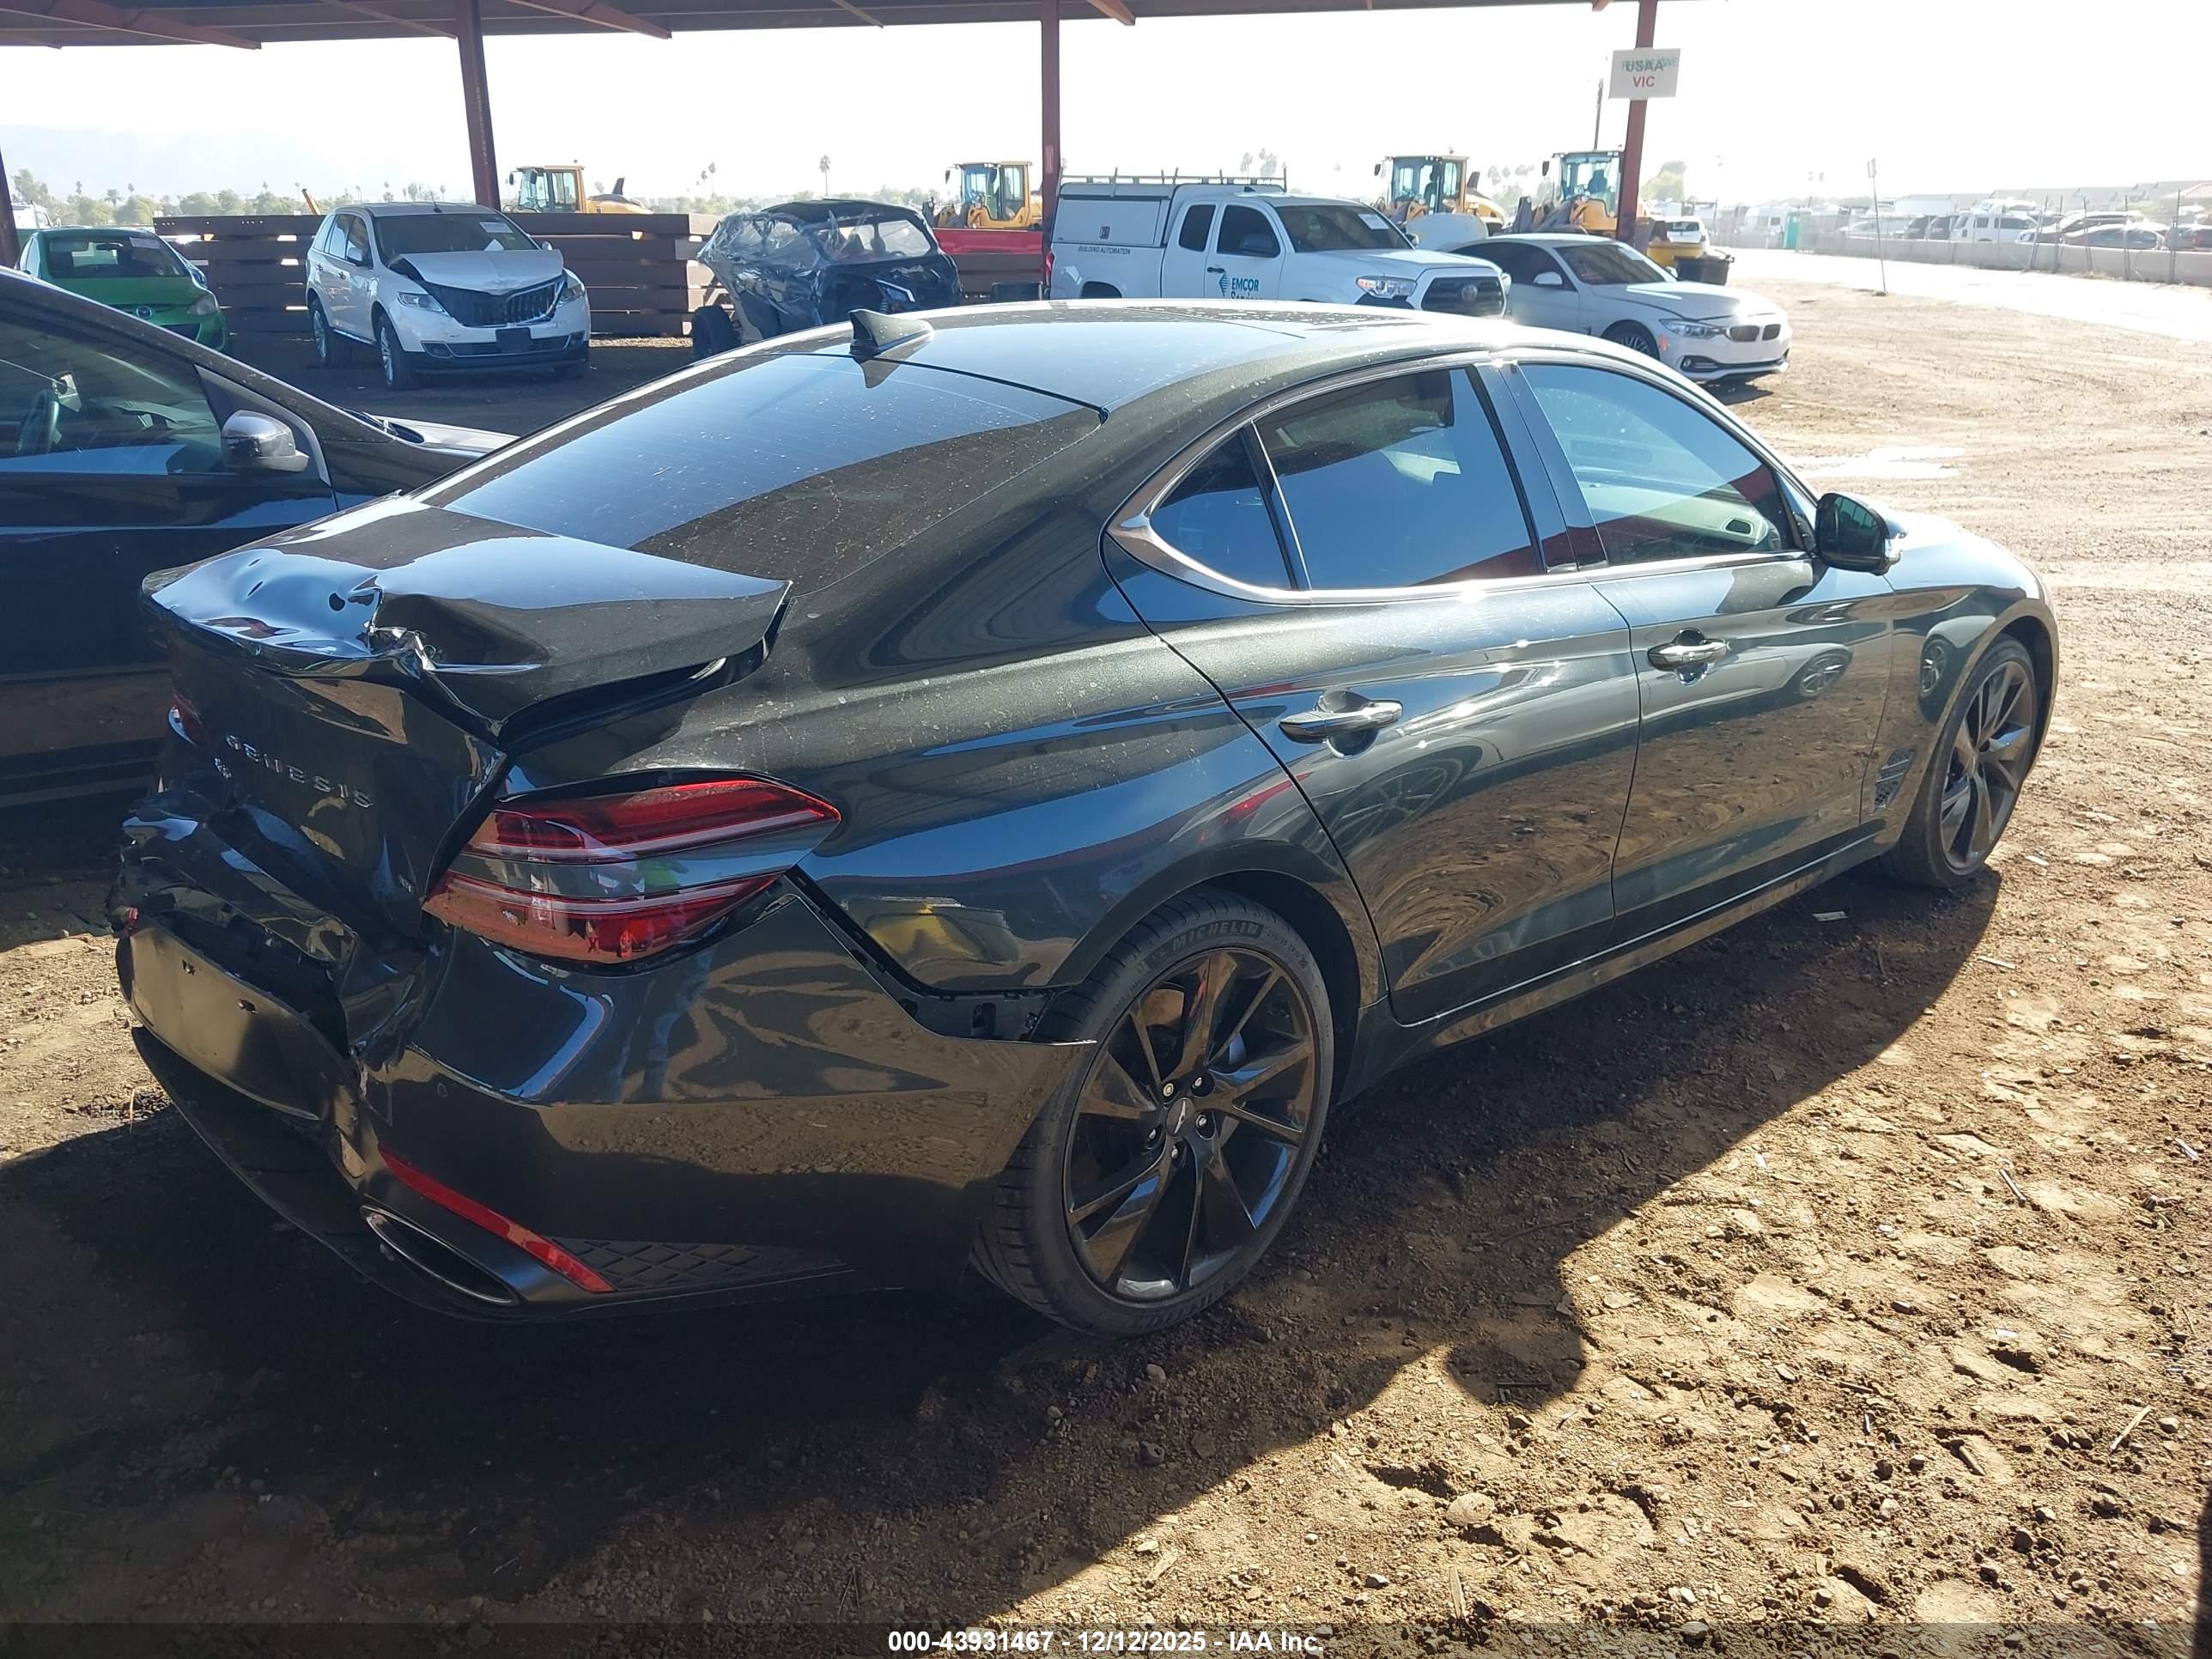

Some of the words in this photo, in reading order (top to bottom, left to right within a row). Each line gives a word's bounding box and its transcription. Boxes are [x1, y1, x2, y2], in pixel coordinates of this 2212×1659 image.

[1625, 60, 1663, 72] USAA
[1633, 76, 1656, 88] VIC
[1100, 246, 1131, 255] AUTOMATION
[1231, 277, 1260, 292] EMCOR
[226, 735, 374, 808] GENESIS
[1172, 921, 1259, 952] MICHELIN
